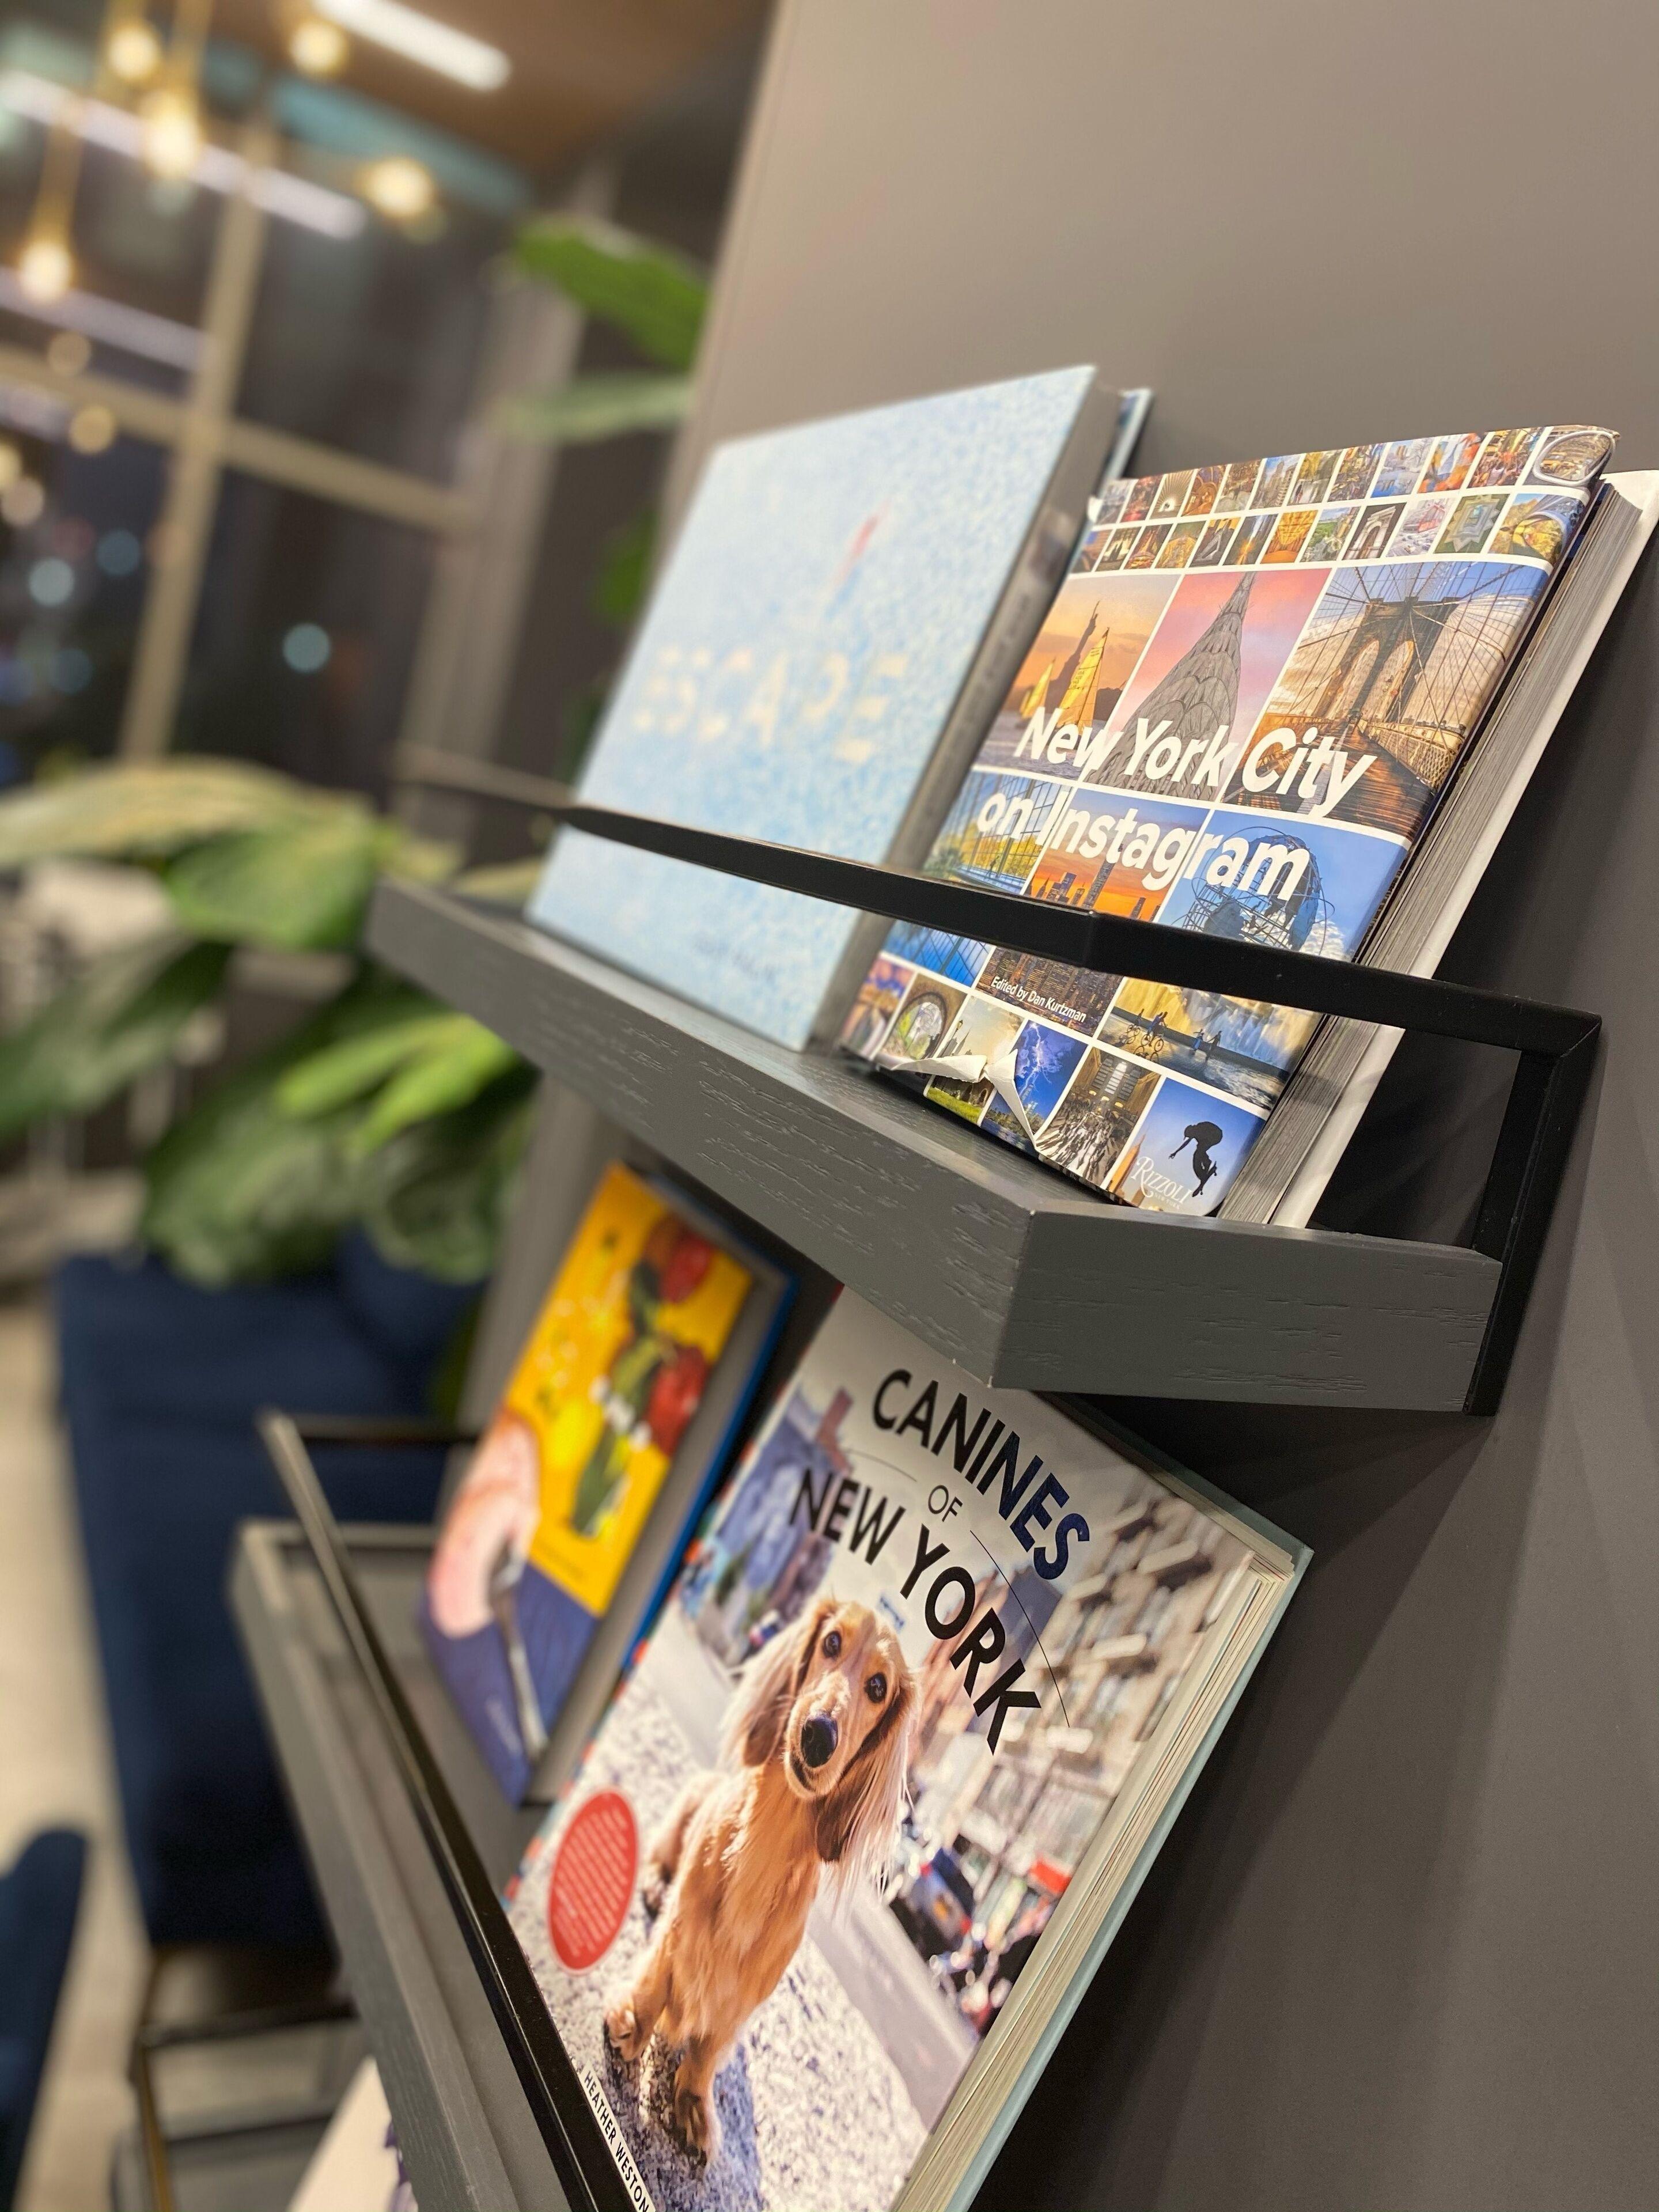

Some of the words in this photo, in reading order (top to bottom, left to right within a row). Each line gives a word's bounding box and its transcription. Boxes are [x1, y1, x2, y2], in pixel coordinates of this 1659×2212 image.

[1014, 706, 1123, 772] New
[1123, 717, 1238, 787] York
[1242, 726, 1378, 819] City
[977, 792, 1036, 841] on
[1036, 791, 1309, 901] Instagram
[990, 976, 1018, 996] Edited
[1016, 986, 1029, 1002] by
[1027, 990, 1046, 1007] Dan
[1044, 997, 1087, 1022] Kurtzman
[873, 1369, 1090, 1580] CANINES
[927, 1484, 963, 1522] OF
[789, 1466, 906, 1566] NEW
[900, 1524, 1041, 1755] YORK
[584, 2070, 616, 2145] HEATHER
[615, 2142, 650, 2212] WESTON
